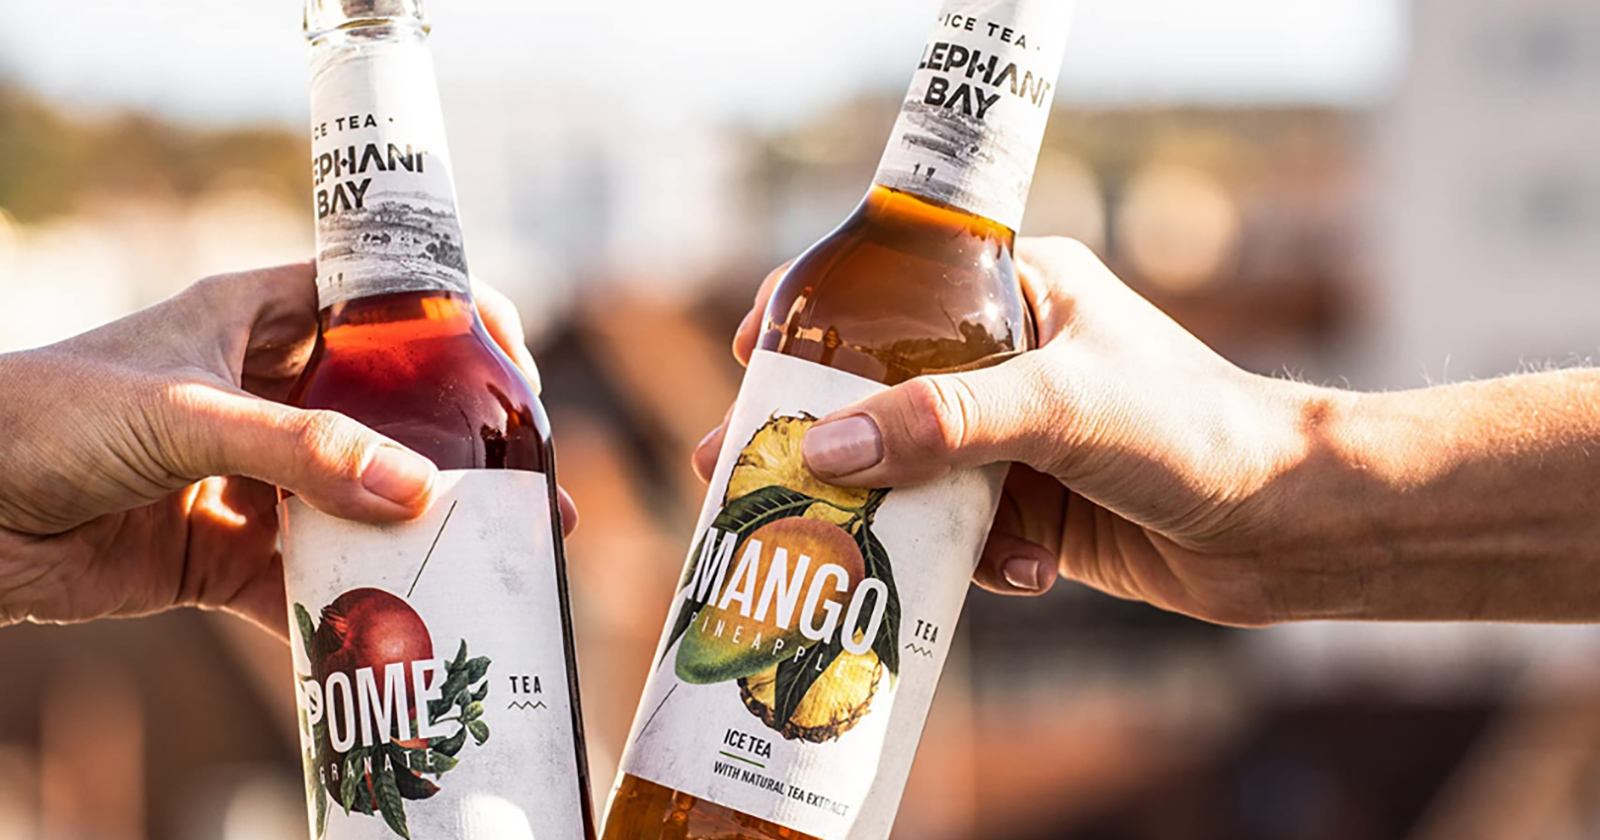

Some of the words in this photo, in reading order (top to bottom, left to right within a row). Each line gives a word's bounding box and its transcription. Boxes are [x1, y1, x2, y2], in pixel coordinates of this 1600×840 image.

[944, 13, 976, 31] ICE
[987, 22, 1027, 49] TEA
[923, 76, 1001, 119] BAY
[335, 113, 377, 131] TEA
[317, 178, 371, 219] BAY
[686, 526, 889, 655] MANGO
[690, 611, 847, 678] PINEAPPLE
[914, 619, 939, 643] TEA
[509, 676, 542, 694] TEA
[302, 658, 448, 759] POME
[723, 728, 748, 750] ICE
[747, 736, 773, 759] TEA
[319, 747, 434, 785] GRANATE
[713, 761, 742, 781] WITH
[741, 770, 785, 796] NATURAL
[787, 785, 804, 802] TEA
